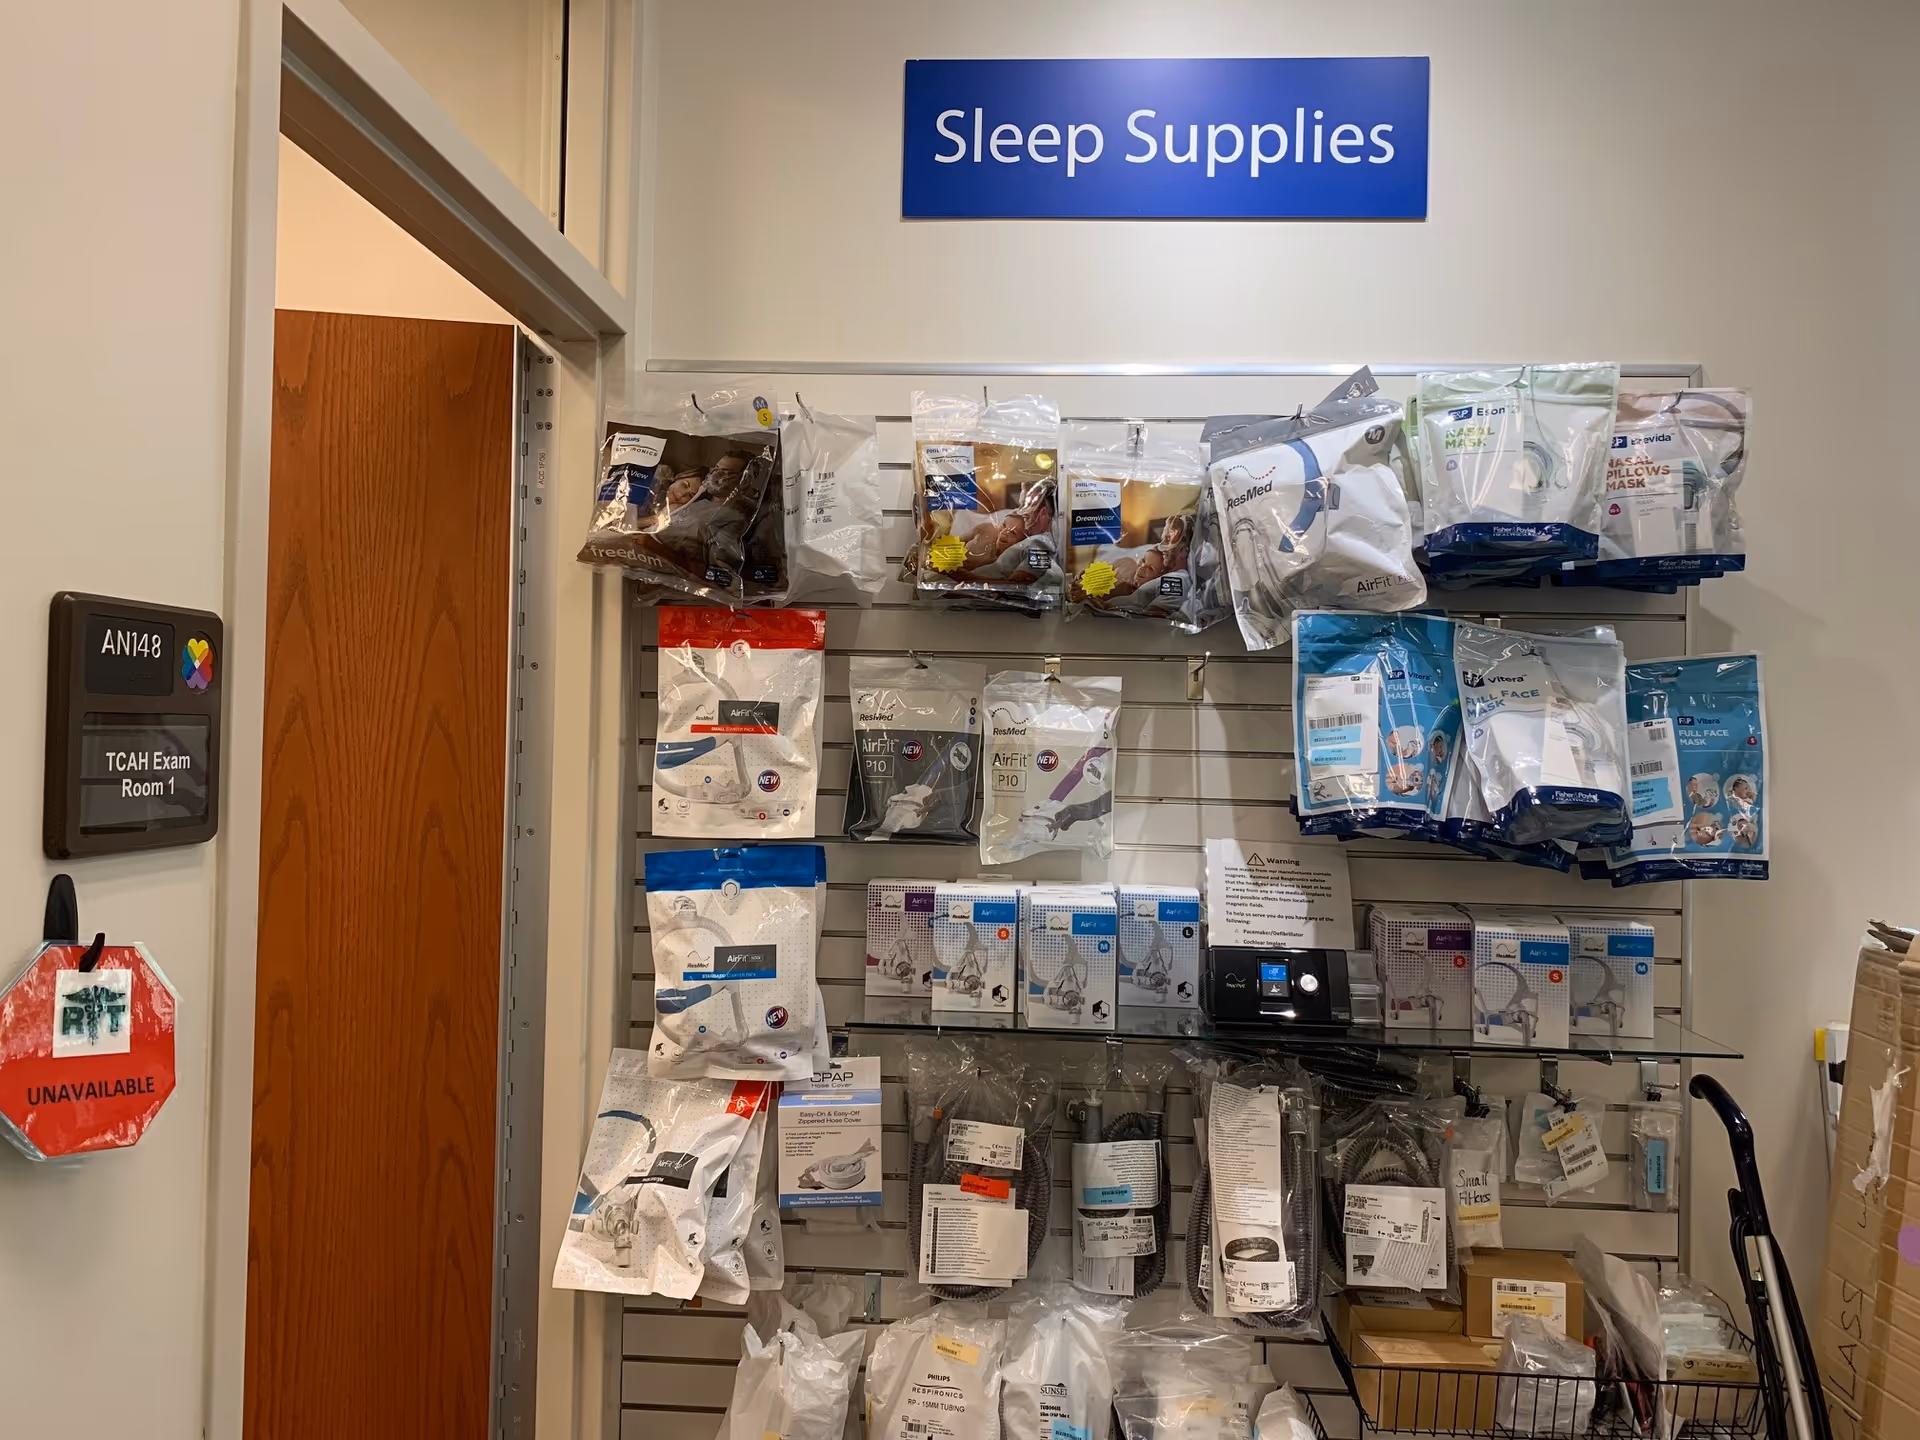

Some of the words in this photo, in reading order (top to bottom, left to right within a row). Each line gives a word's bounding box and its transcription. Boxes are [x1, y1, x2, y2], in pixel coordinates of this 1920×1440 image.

[933, 107, 1104, 177] Sleep
[1124, 107, 1395, 177] Supplies
[1366, 428, 1383, 442] M
[1606, 465, 1671, 480] PILLOWS
[1606, 478, 1646, 492] MASK
[1226, 480, 1273, 511] ResMed
[1075, 514, 1116, 522] DreamWear
[589, 546, 664, 569] freedom
[1356, 576, 1392, 593] AirFit
[101, 629, 161, 659] AN148
[1413, 684, 1437, 694] FACE
[1501, 688, 1541, 699] FACE
[1387, 692, 1414, 700] MASK
[1467, 698, 1506, 718] MASK
[859, 713, 894, 722] ResMed
[992, 727, 1027, 736] ResMed
[1678, 729, 1703, 737] FULL
[1703, 729, 1730, 737] FACE
[1679, 738, 1707, 746] MASK
[902, 745, 922, 755] NEW
[106, 751, 149, 772] TCAH
[153, 751, 191, 770] Exam
[1037, 755, 1057, 765] NEW
[866, 760, 887, 773] P10
[758, 775, 779, 785] NEW
[998, 774, 1019, 787] P10
[122, 778, 164, 798] Room
[168, 776, 175, 796] 1
[1266, 857, 1300, 866] Warning
[1000, 930, 1007, 938] S
[1101, 942, 1109, 951] M
[766, 1008, 785, 1026] NEW
[810, 1071, 854, 1083] CPAP
[26, 1076, 156, 1106] UNAVAILABLE
[799, 1111, 825, 1119] Easy-On
[833, 1110, 860, 1118] Easy-Off
[1456, 1169, 1489, 1188] Small
[927, 1373, 951, 1382] PHILIPS
[911, 1387, 964, 1399] RESPIRONICS
[1040, 1386, 1068, 1396] SUNSET
[907, 1398, 917, 1406] RP
[922, 1400, 939, 1409] 15MM
[940, 1402, 965, 1413] TUBING
